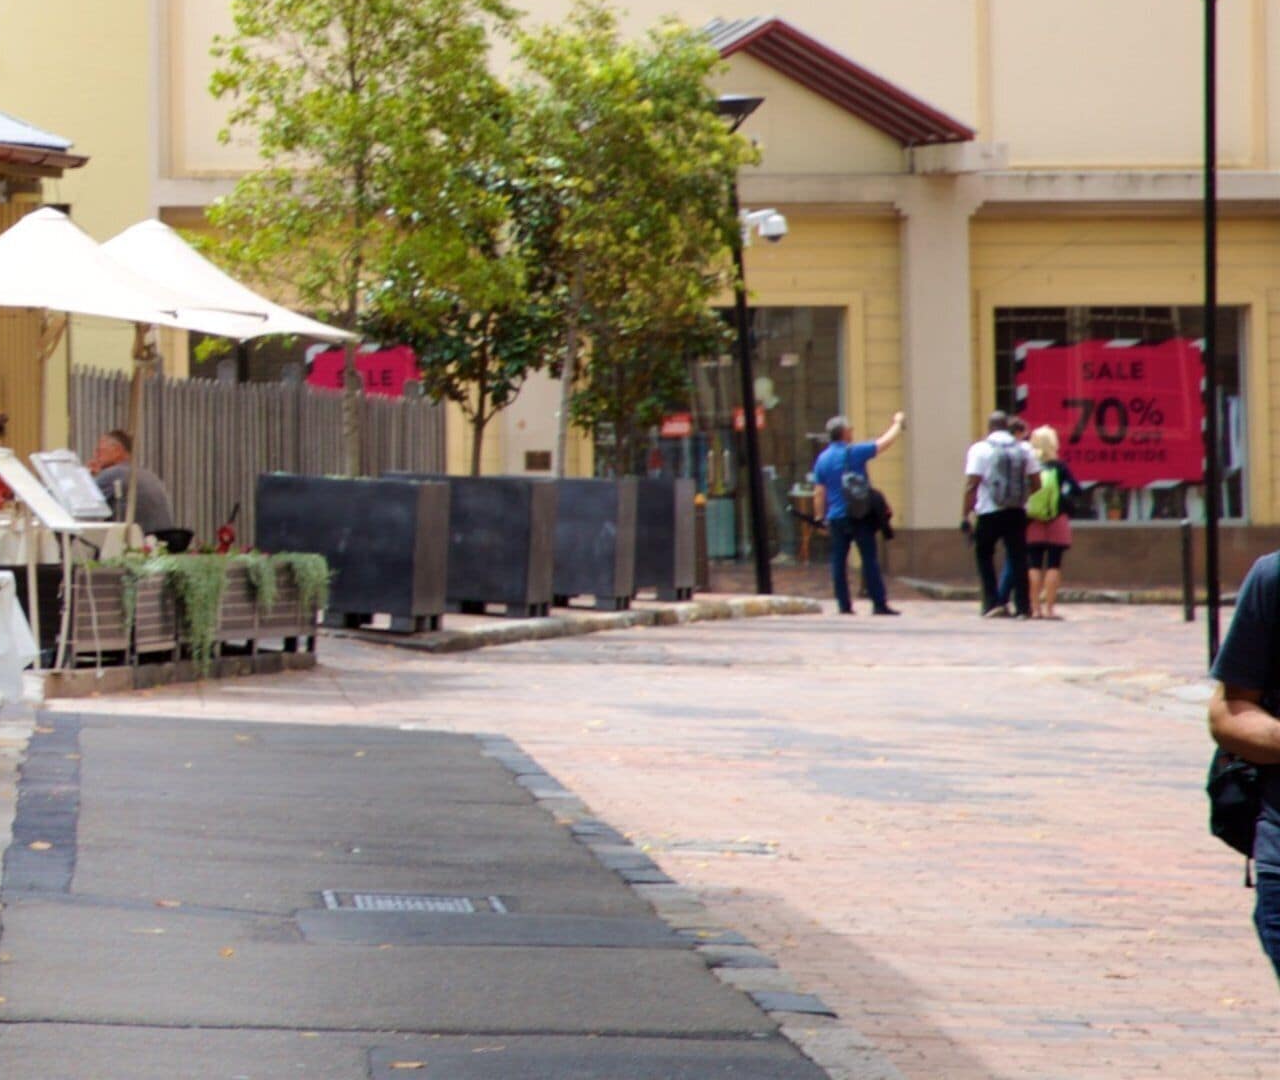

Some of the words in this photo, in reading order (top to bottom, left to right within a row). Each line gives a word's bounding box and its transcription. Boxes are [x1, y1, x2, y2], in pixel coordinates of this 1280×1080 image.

[336, 369, 394, 389] SLE
[1082, 361, 1145, 381] SALE
[1061, 397, 1165, 445] 70%
